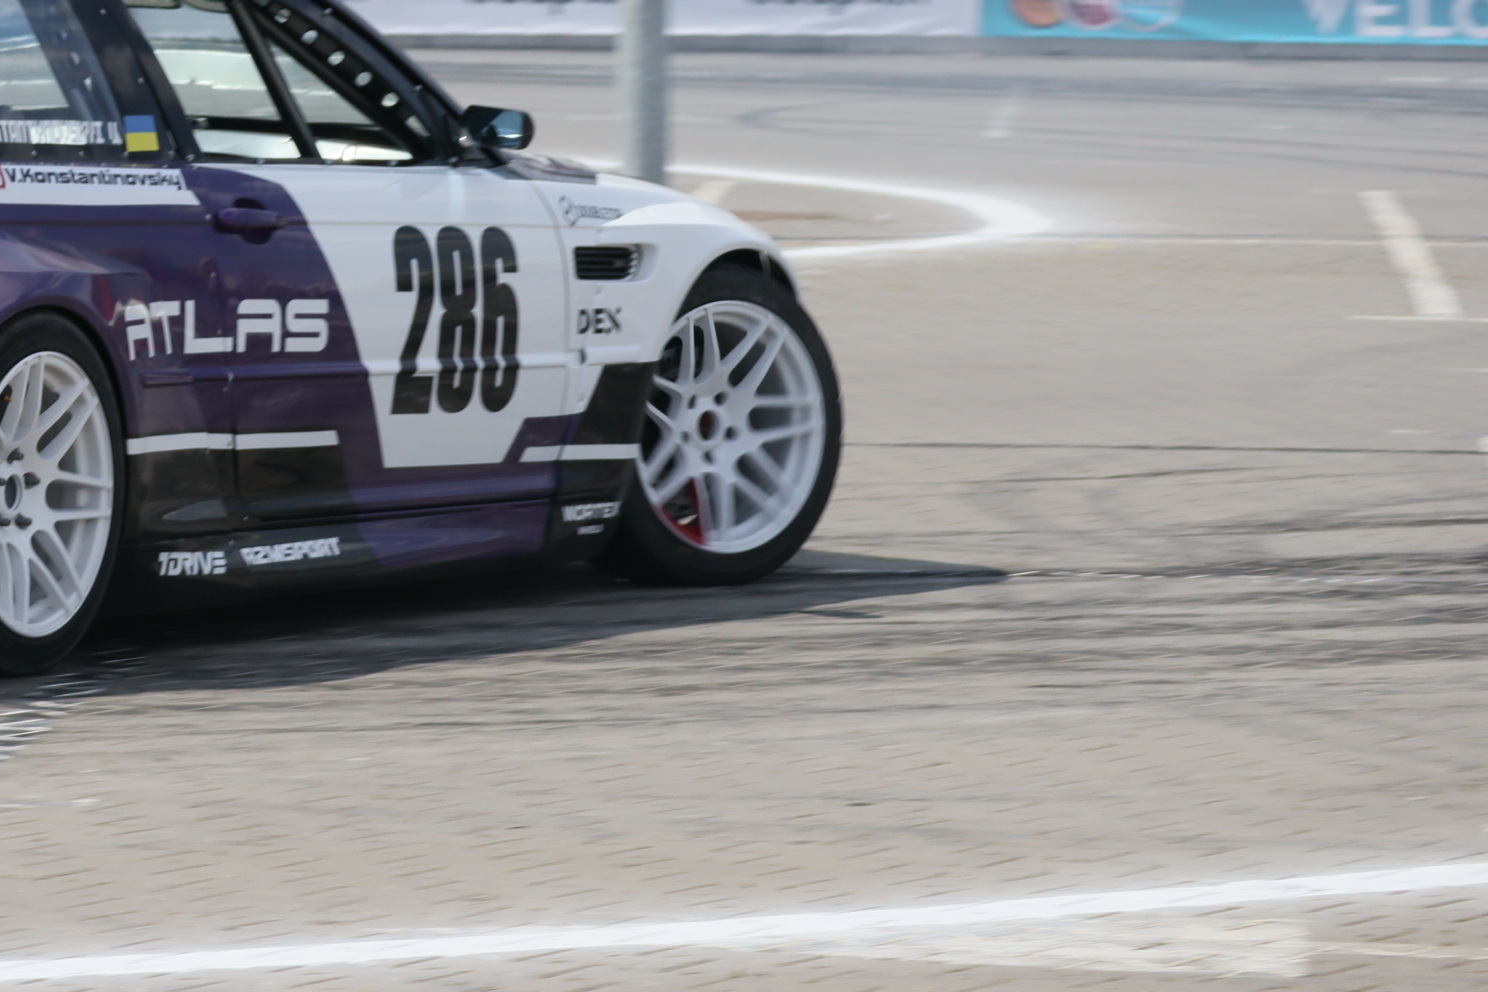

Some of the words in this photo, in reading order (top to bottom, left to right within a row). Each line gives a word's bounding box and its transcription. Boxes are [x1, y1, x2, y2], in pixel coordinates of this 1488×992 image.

[124, 299, 330, 362] ATLAS
[390, 225, 521, 415] 286
[576, 307, 622, 335] DEX
